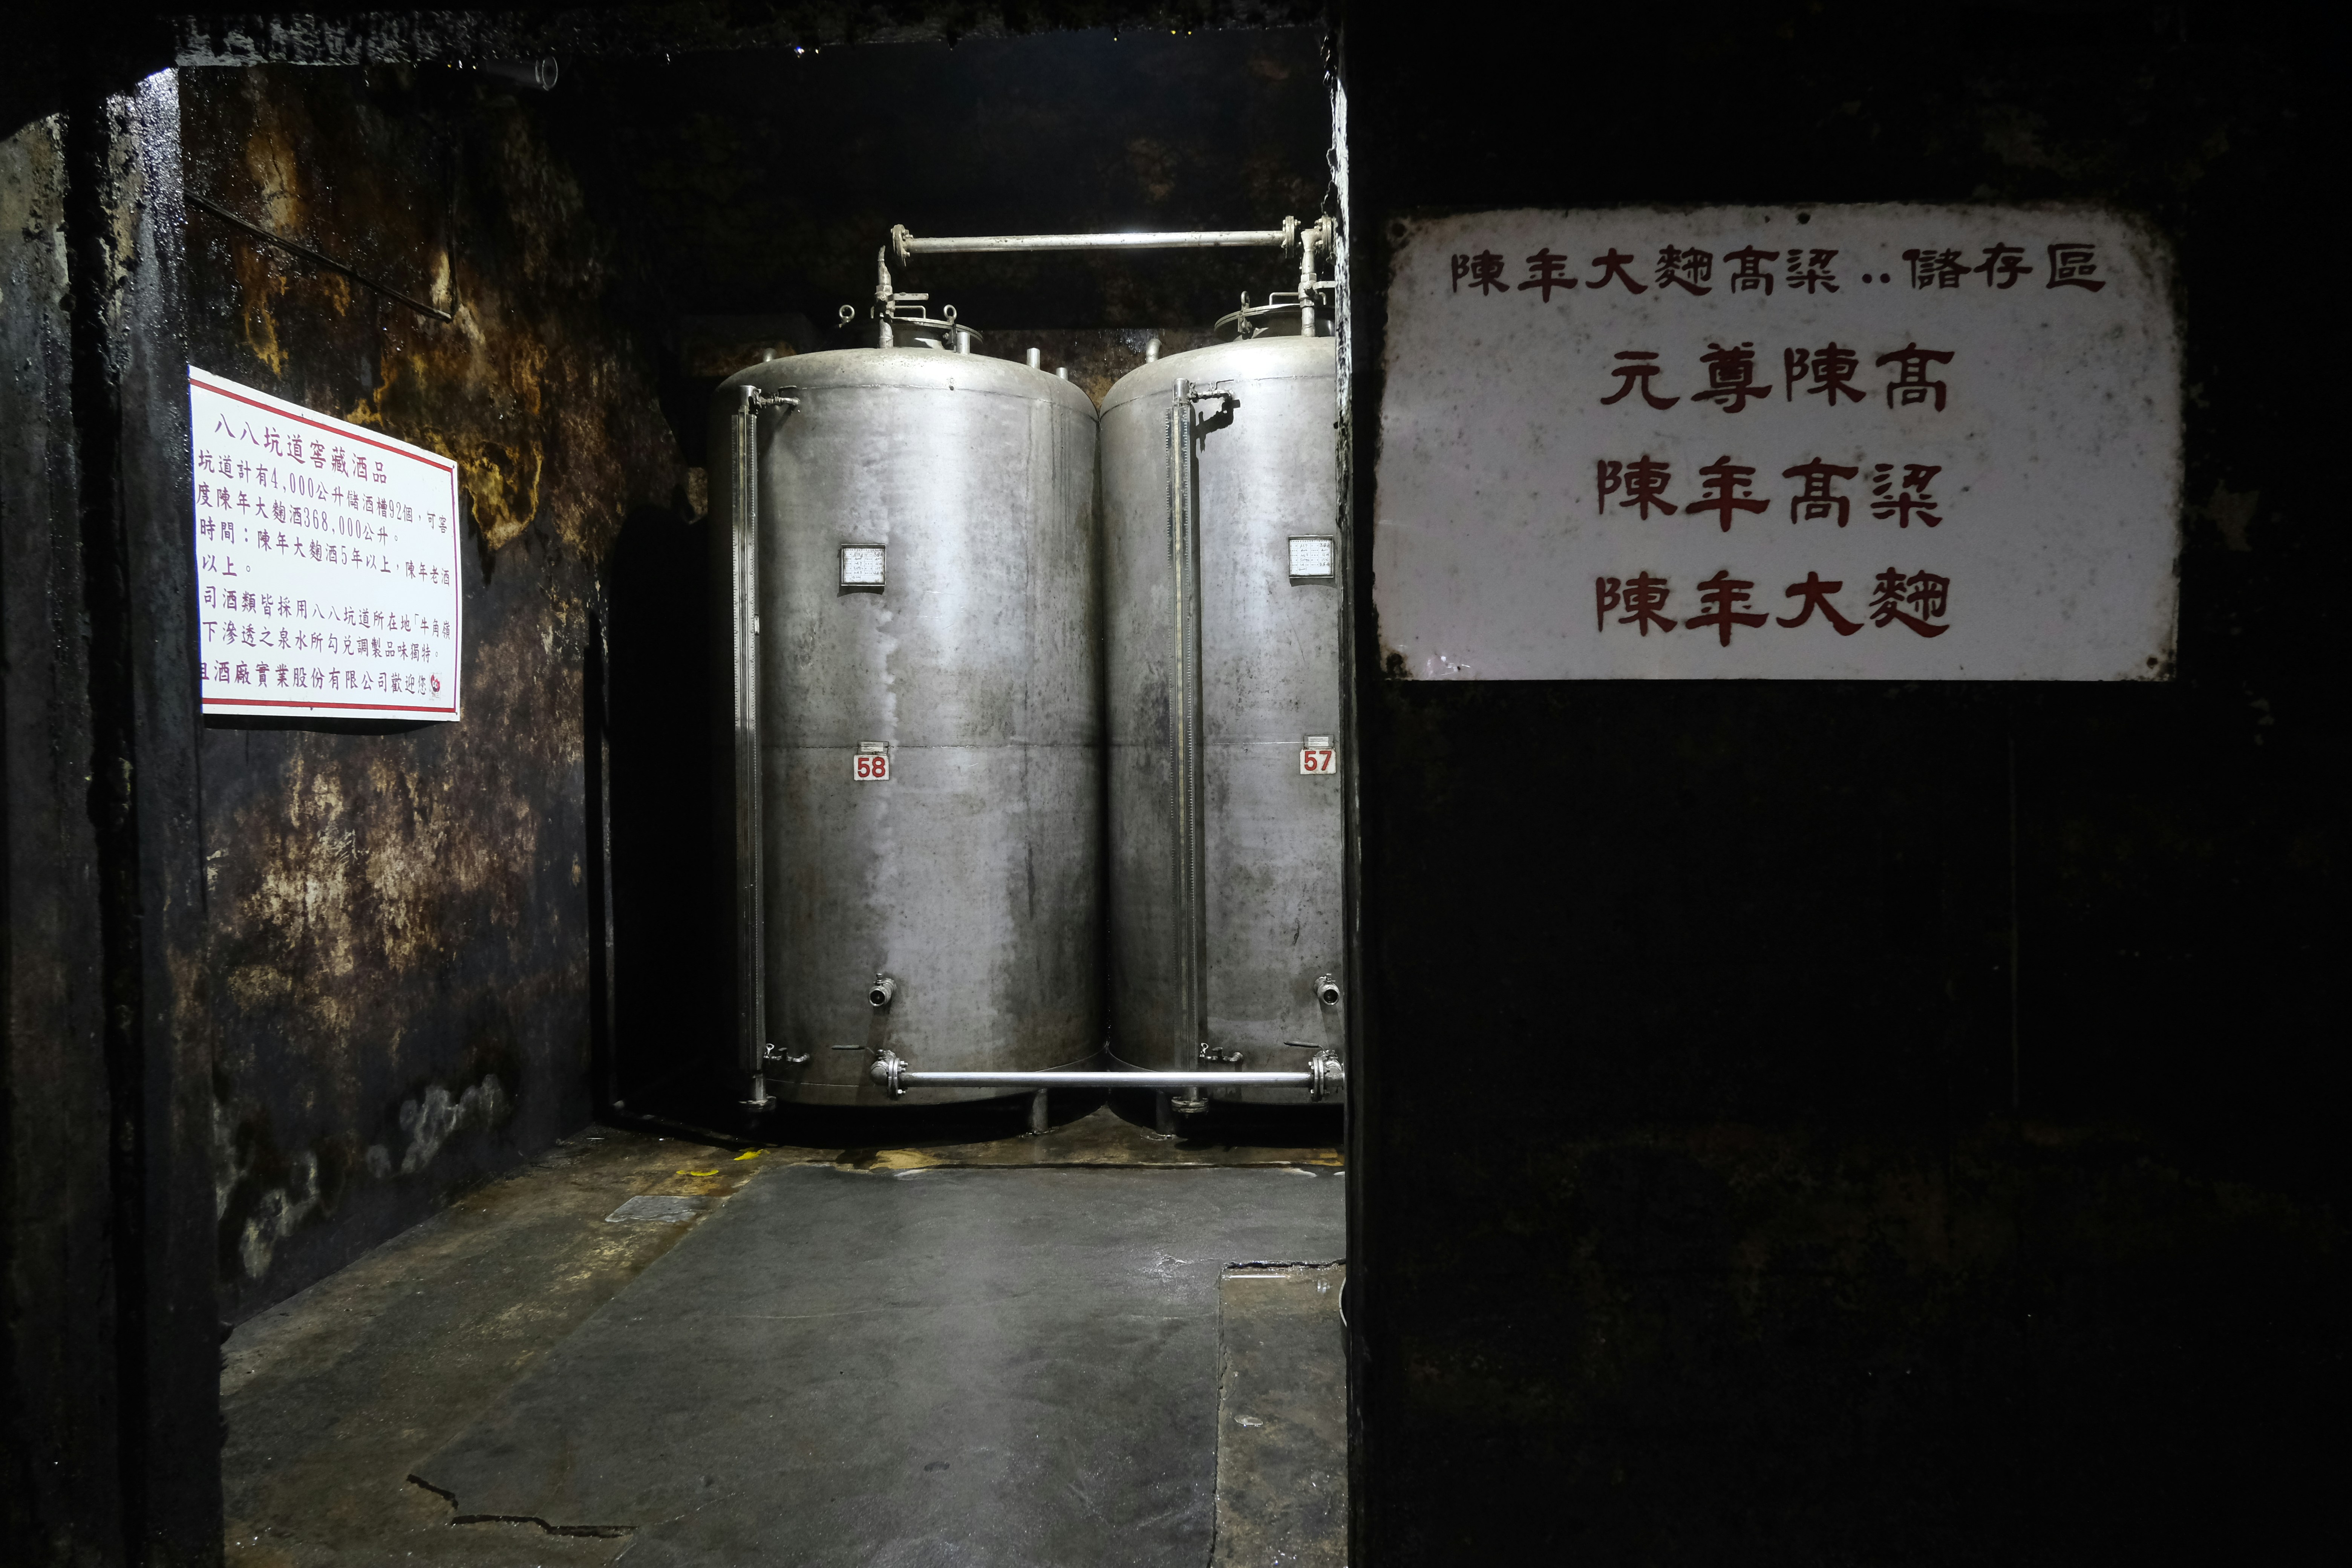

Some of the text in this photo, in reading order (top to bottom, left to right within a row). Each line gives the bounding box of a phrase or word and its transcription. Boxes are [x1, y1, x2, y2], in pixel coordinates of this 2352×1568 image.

[215, 413, 386, 483] 八八坑道窖藏酒品
[203, 555, 250, 576] 以上。
[858, 757, 885, 778] 58
[1304, 750, 1332, 771] 57
